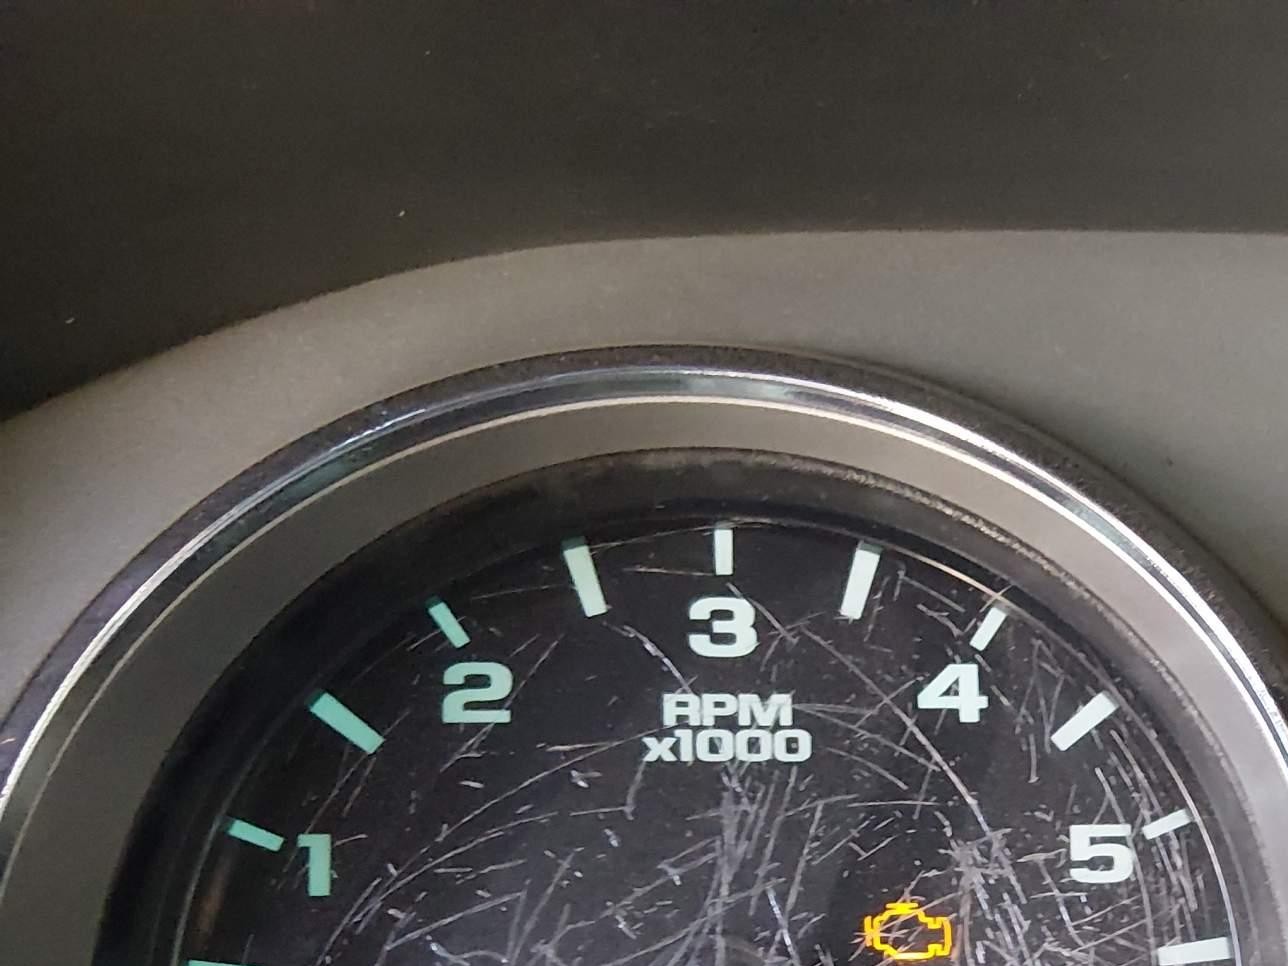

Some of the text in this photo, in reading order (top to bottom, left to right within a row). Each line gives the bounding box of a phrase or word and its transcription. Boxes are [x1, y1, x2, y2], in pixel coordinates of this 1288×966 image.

[688, 597, 758, 658] 3
[441, 662, 513, 724] 2
[661, 692, 793, 727] RPM
[917, 663, 988, 723] 4
[643, 728, 812, 763] x1000
[297, 833, 332, 897] 1
[1069, 823, 1137, 884] 5
